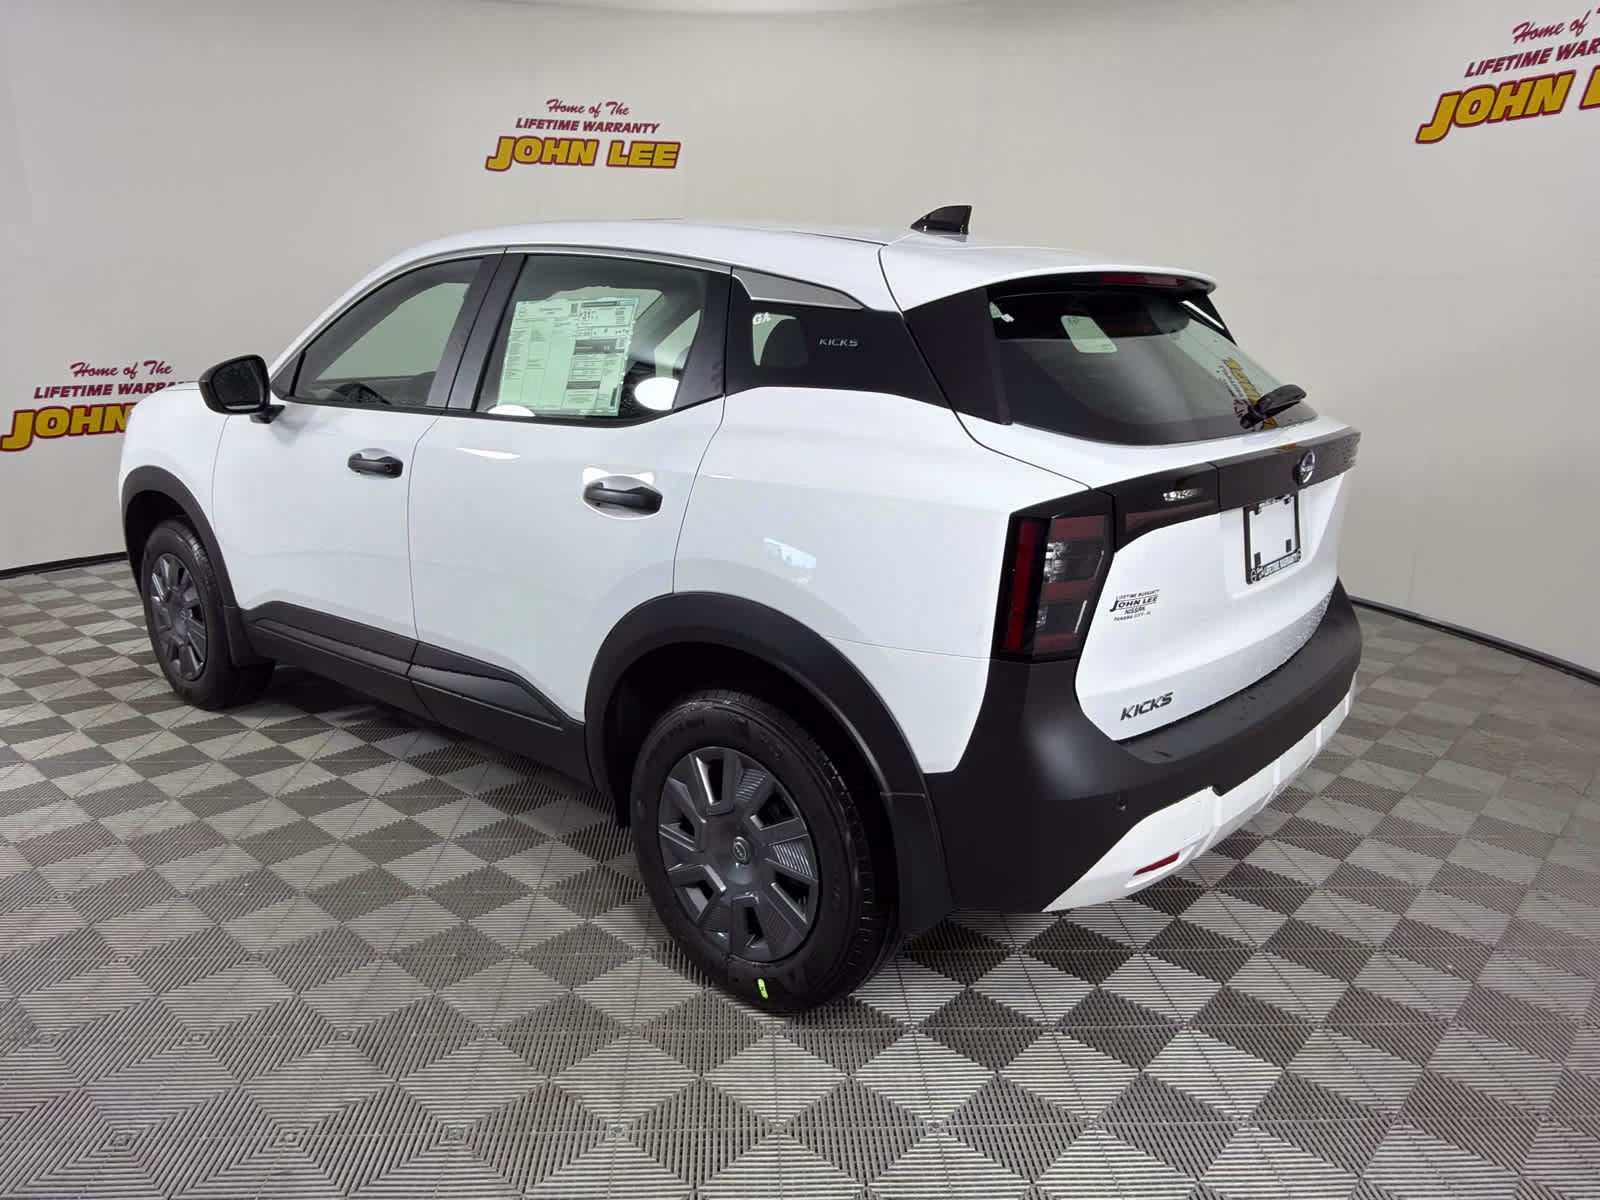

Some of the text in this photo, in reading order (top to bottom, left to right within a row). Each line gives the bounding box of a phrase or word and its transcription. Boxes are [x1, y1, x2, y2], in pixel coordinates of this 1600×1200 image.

[1512, 9, 1592, 44] Home of
[1464, 47, 1553, 78] LIFETIME
[546, 98, 630, 118] Home of The
[1415, 70, 1577, 144] JOHN
[515, 117, 661, 134] LIFETIME WARRANTY
[485, 135, 681, 172] JOHN LEE
[819, 337, 859, 348] KICKS
[70, 360, 173, 380] Home of The
[33, 383, 114, 400] LIFETIME
[0, 401, 138, 453] JOHN
[1109, 596, 1158, 612] JOHN LEE
[1120, 691, 1174, 721] KICKS
